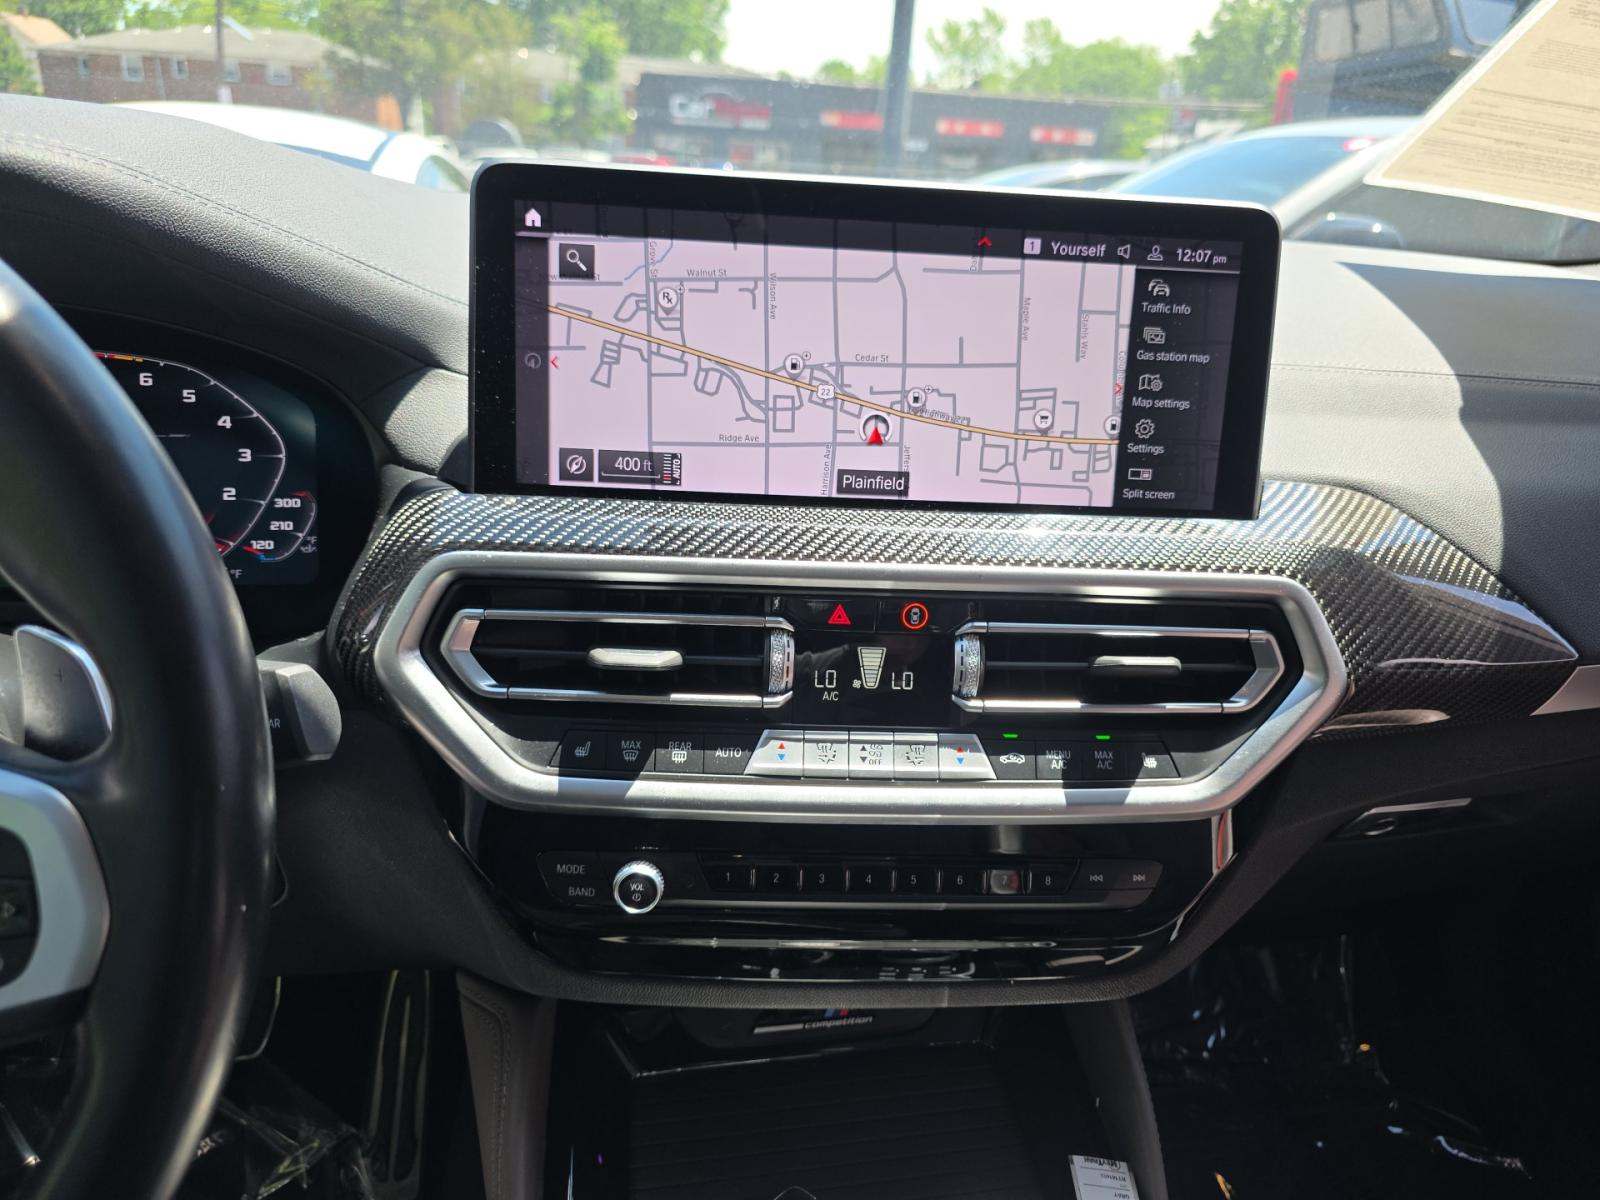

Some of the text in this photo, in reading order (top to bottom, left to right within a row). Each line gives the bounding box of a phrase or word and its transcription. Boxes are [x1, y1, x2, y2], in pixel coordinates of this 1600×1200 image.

[1051, 242, 1106, 257] Yourself
[1176, 249, 1227, 265] 12:07 pm
[686, 268, 728, 277] Walnut St
[769, 272, 777, 320] Wilson Ave
[1141, 302, 1191, 315] Traffic Info
[1022, 297, 1031, 341] Maple Ave
[855, 353, 889, 362] Cedar St
[1136, 350, 1210, 364] Gas station map
[139, 372, 153, 386] 6
[183, 389, 197, 403] 5
[1132, 396, 1152, 408] Map
[1154, 398, 1191, 411] settings
[217, 415, 232, 429] 4
[718, 433, 741, 443] Ridge
[238, 448, 252, 462] 3
[1127, 443, 1165, 456] Settings
[614, 456, 653, 472] 400 ft
[672, 459, 681, 479] AUTO
[820, 444, 833, 496] Harrison Ave
[842, 474, 905, 491] Plainfield
[222, 488, 236, 501] 2
[1122, 488, 1175, 500] Split screen
[274, 498, 301, 508] 300
[269, 521, 294, 531] 210
[251, 540, 275, 550] 120
[814, 670, 836, 689] LO
[891, 671, 914, 690] LO
[822, 691, 839, 701] A/C
[269, 718, 281, 729] AR
[621, 740, 641, 750] MAX
[668, 741, 693, 751] REAR
[715, 747, 742, 758] AUTO
[1045, 750, 1071, 759] MENU
[1094, 750, 1114, 759] MAX
[869, 758, 881, 766] OFF
[1051, 759, 1068, 769] A/C
[1097, 760, 1113, 770] A/C
[556, 864, 586, 875] MODE
[772, 872, 780, 883] 2
[818, 873, 826, 884] 3
[865, 874, 872, 884] 4
[910, 875, 918, 885] 5
[957, 875, 964, 886] 6
[1044, 875, 1052, 886] 8
[568, 886, 596, 897] BAND
[630, 882, 645, 891] VOL
[803, 1015, 873, 1030] competition
